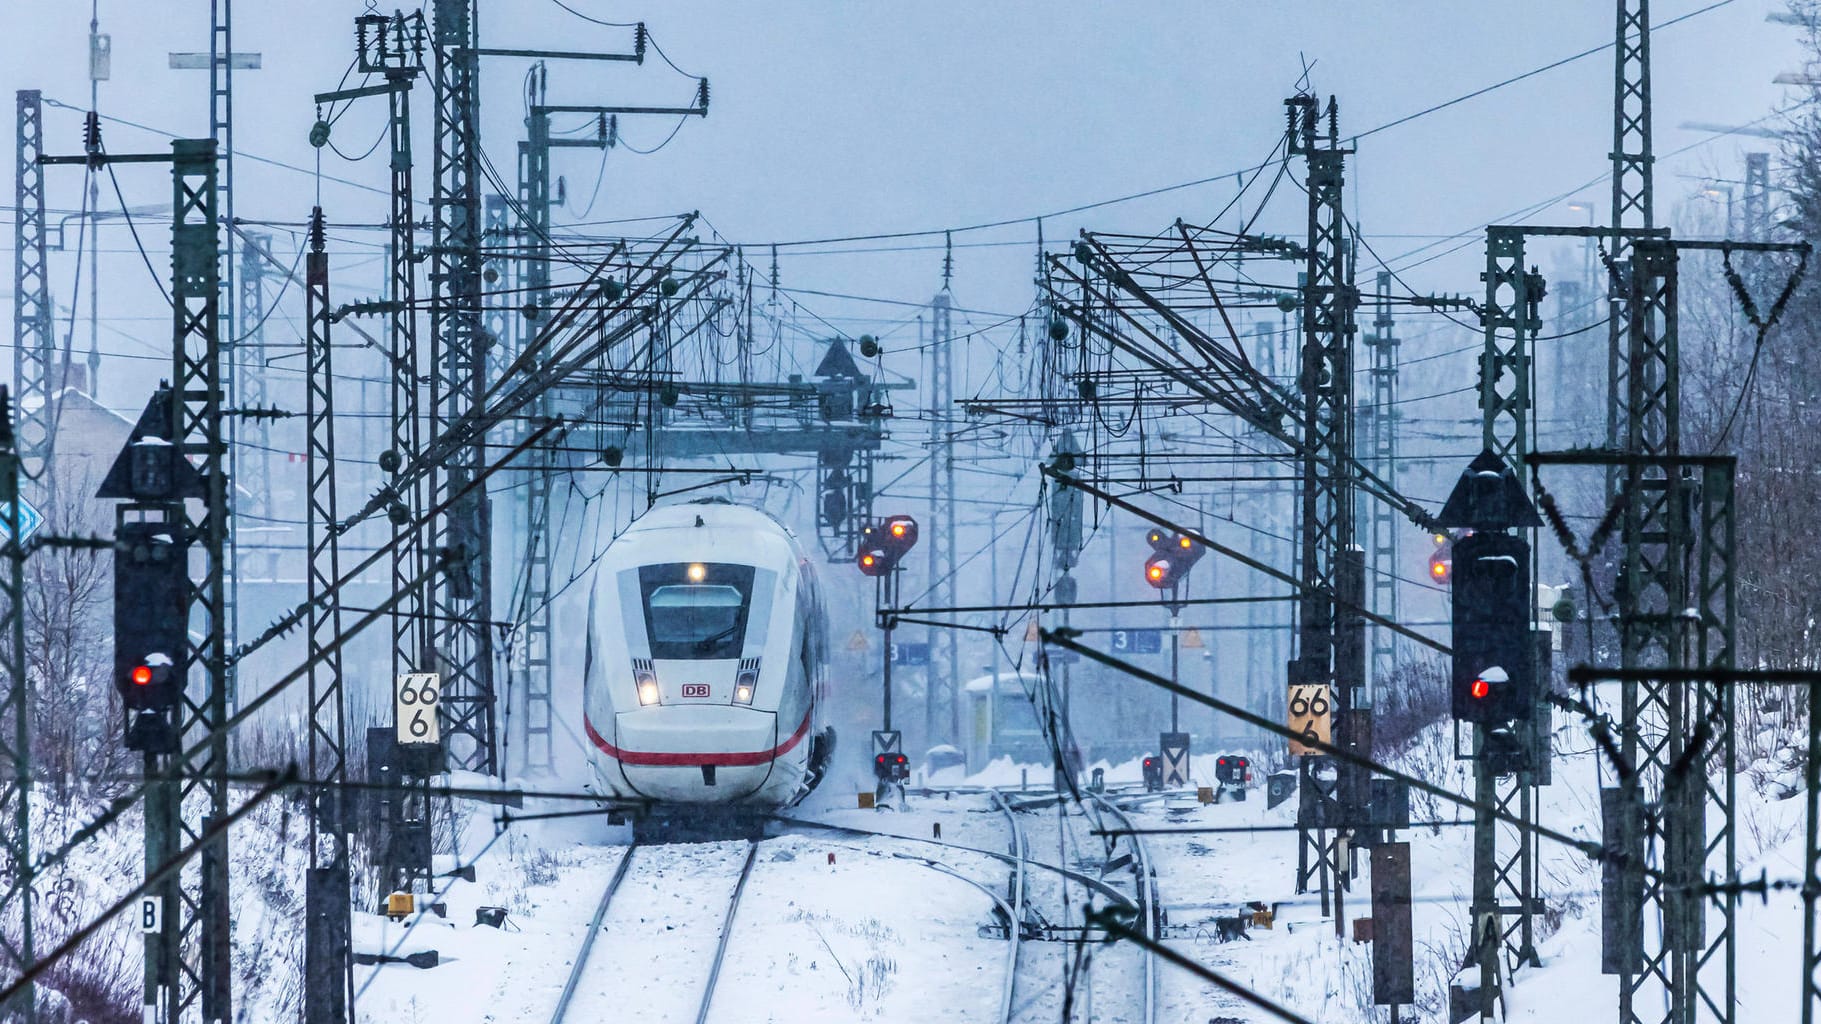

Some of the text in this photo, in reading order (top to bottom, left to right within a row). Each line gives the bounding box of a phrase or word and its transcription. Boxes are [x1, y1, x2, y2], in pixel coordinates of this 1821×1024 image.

[1114, 630, 1127, 649] 3
[400, 677, 438, 705] 66
[1290, 688, 1328, 717] 66
[409, 709, 428, 737] 6
[1301, 719, 1320, 748] 6
[143, 901, 155, 928] B
